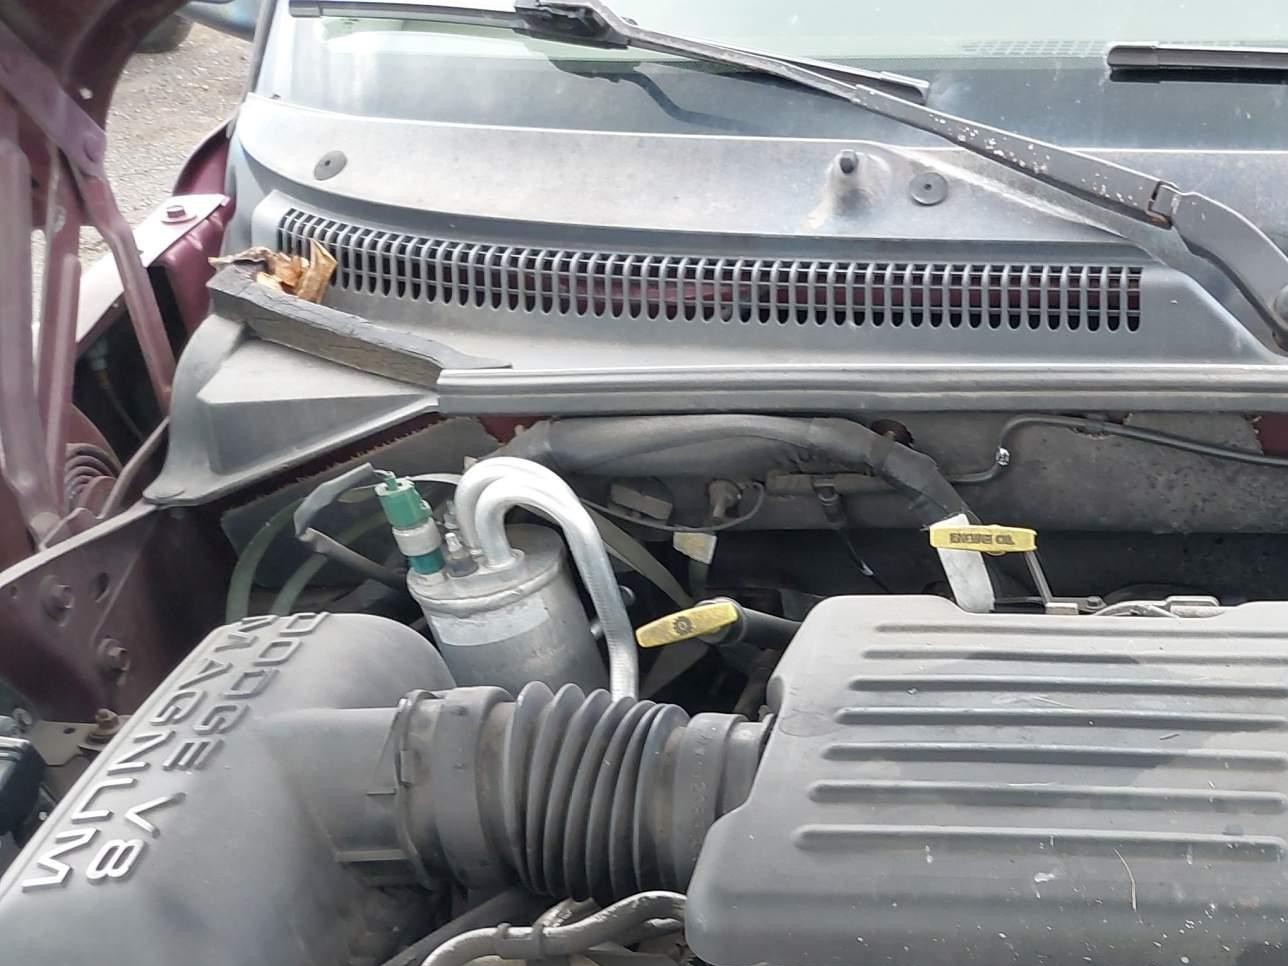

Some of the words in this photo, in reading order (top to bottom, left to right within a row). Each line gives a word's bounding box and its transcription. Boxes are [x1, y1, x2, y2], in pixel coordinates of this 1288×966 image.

[21, 613, 280, 893] MAGNUM
[162, 611, 331, 771] DODGE
[86, 791, 187, 886] V8
